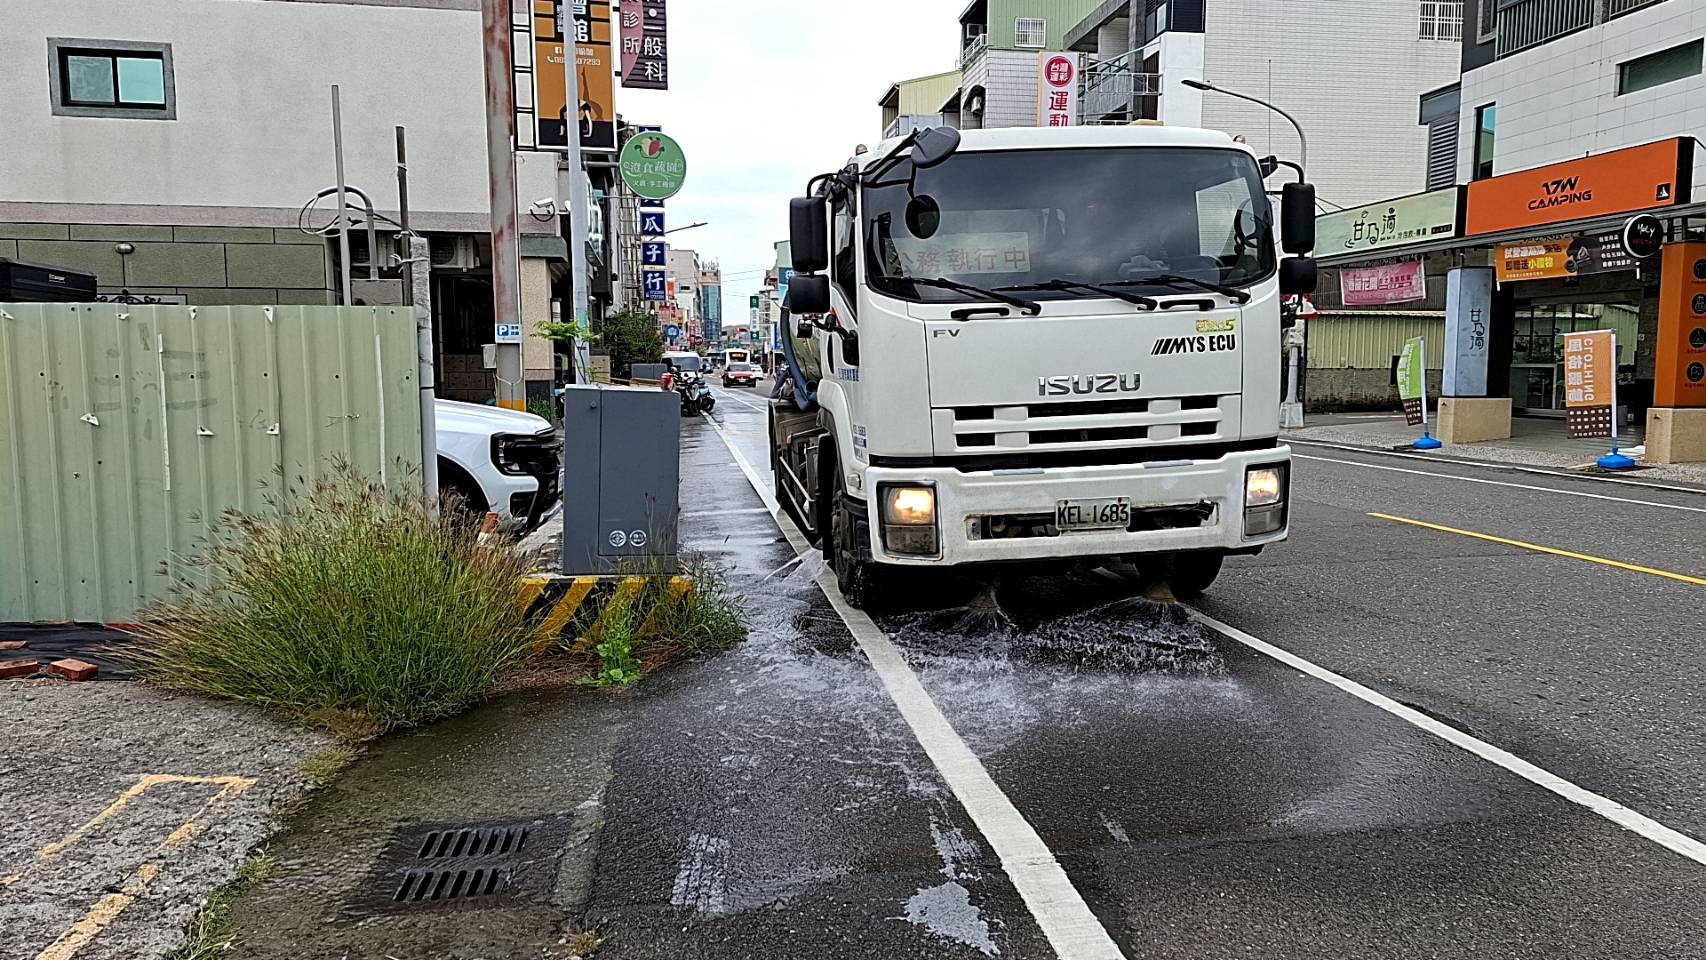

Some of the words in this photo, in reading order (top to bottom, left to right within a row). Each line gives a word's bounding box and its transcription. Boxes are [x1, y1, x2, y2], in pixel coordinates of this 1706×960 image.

[623, 0, 640, 54] 診所
[1048, 91, 1069, 126] 運動
[1527, 190, 1592, 211] CAMPING
[933, 329, 960, 338] FV
[1209, 334, 1236, 352] ECU
[1038, 372, 1141, 396] ISUZU
